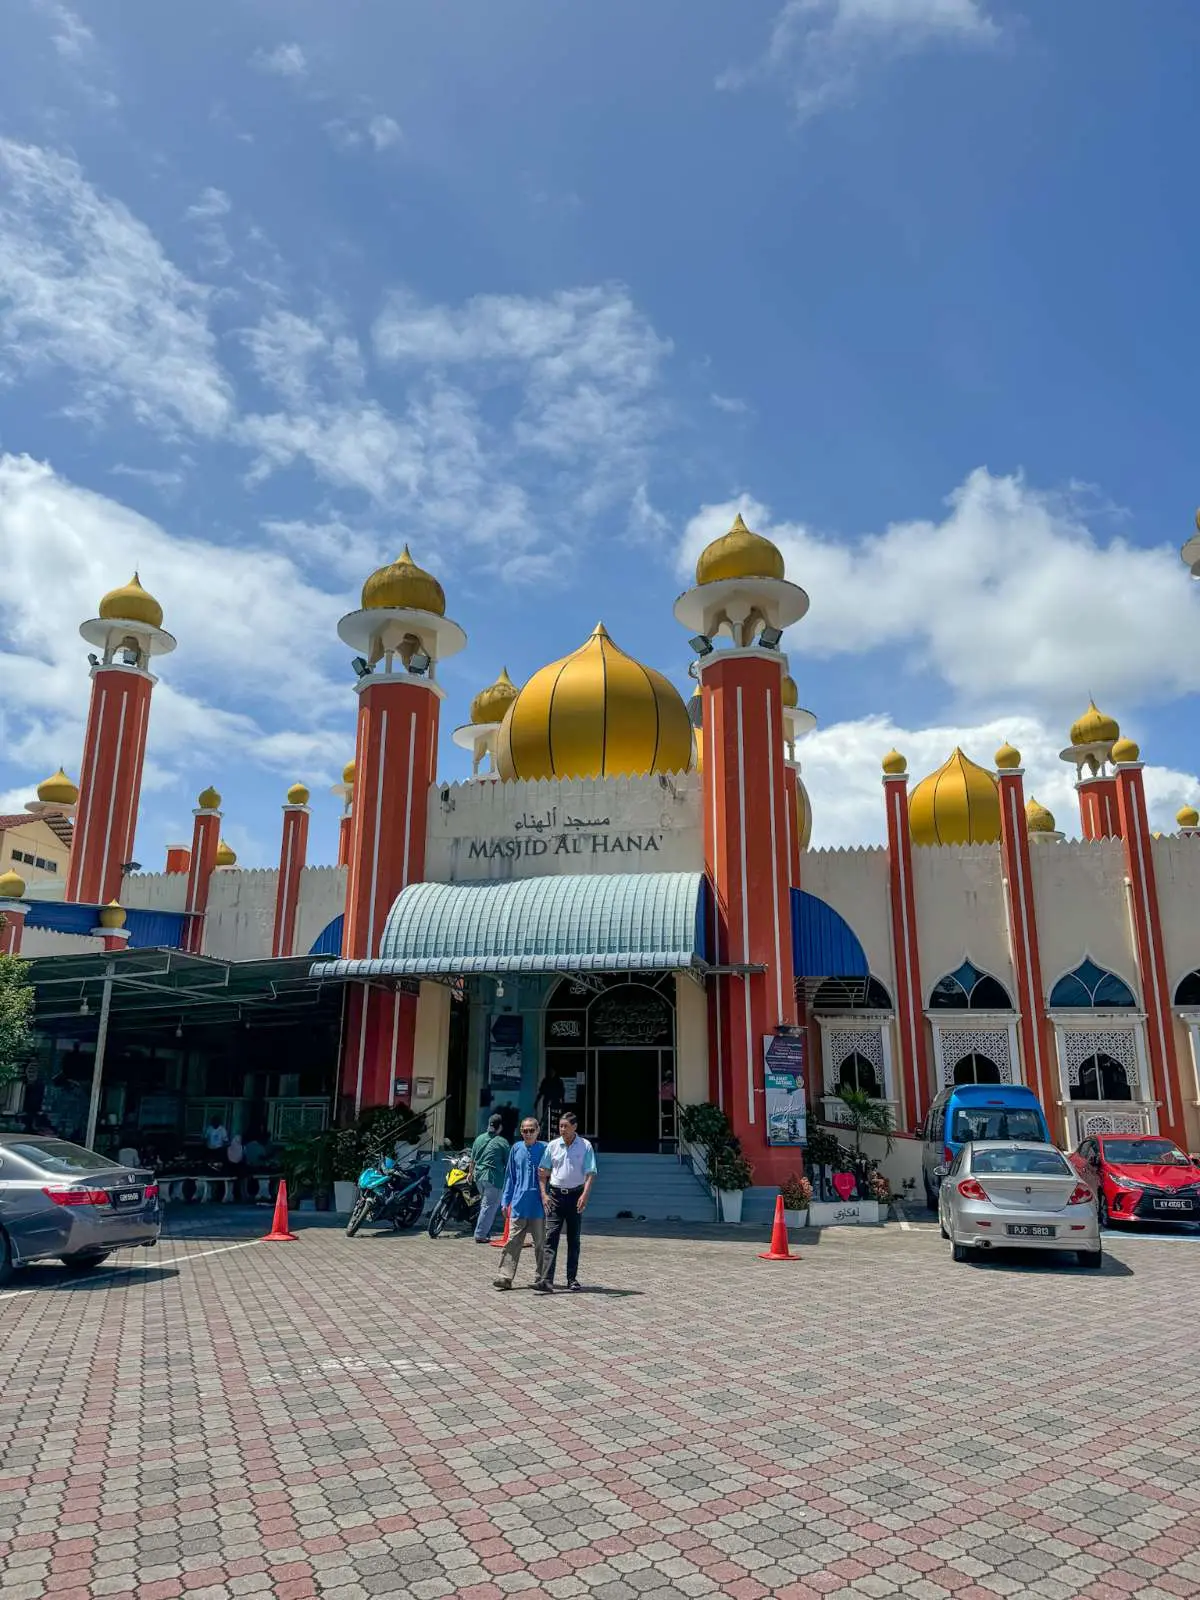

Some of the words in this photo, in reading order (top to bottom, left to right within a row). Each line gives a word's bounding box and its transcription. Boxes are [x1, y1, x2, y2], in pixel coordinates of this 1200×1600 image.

[564, 815, 610, 831] مسجد
[468, 840, 548, 860] MASJID
[553, 834, 583, 854] AL
[592, 835, 664, 853] HANA'
[1014, 1226, 1028, 1234] PJC
